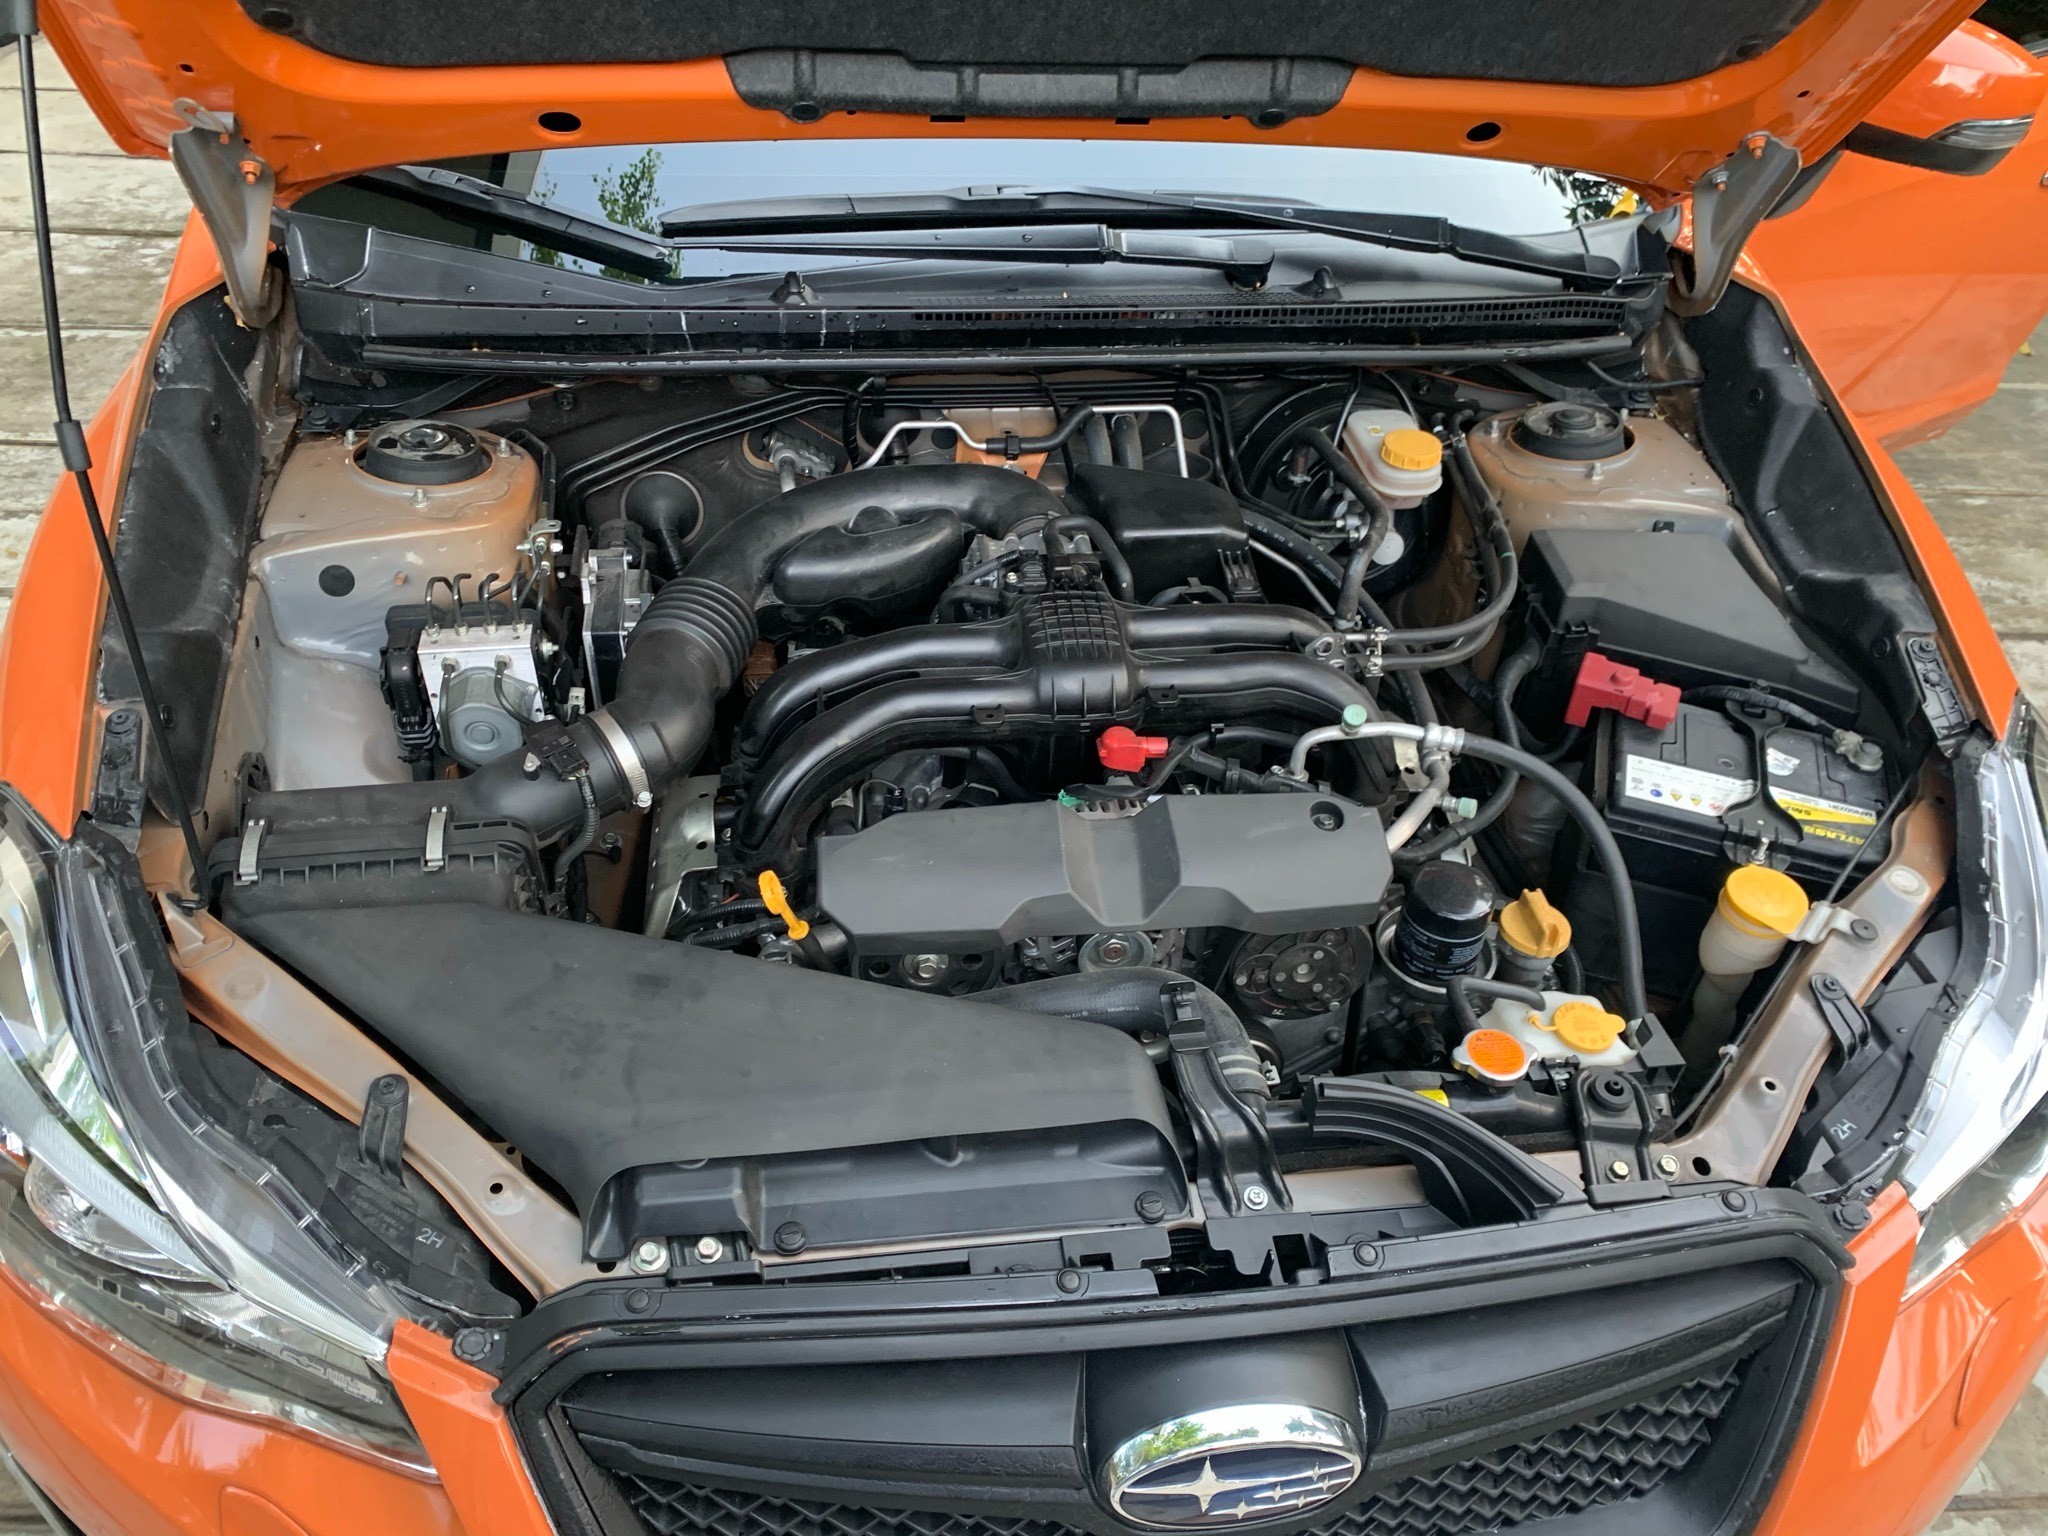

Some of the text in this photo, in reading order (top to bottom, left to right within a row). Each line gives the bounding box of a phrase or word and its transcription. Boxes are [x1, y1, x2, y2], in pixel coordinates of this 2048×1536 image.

[1802, 825, 1866, 845] ATLASB
[1830, 1118, 1857, 1140] 2H
[415, 1227, 446, 1250] 2H
